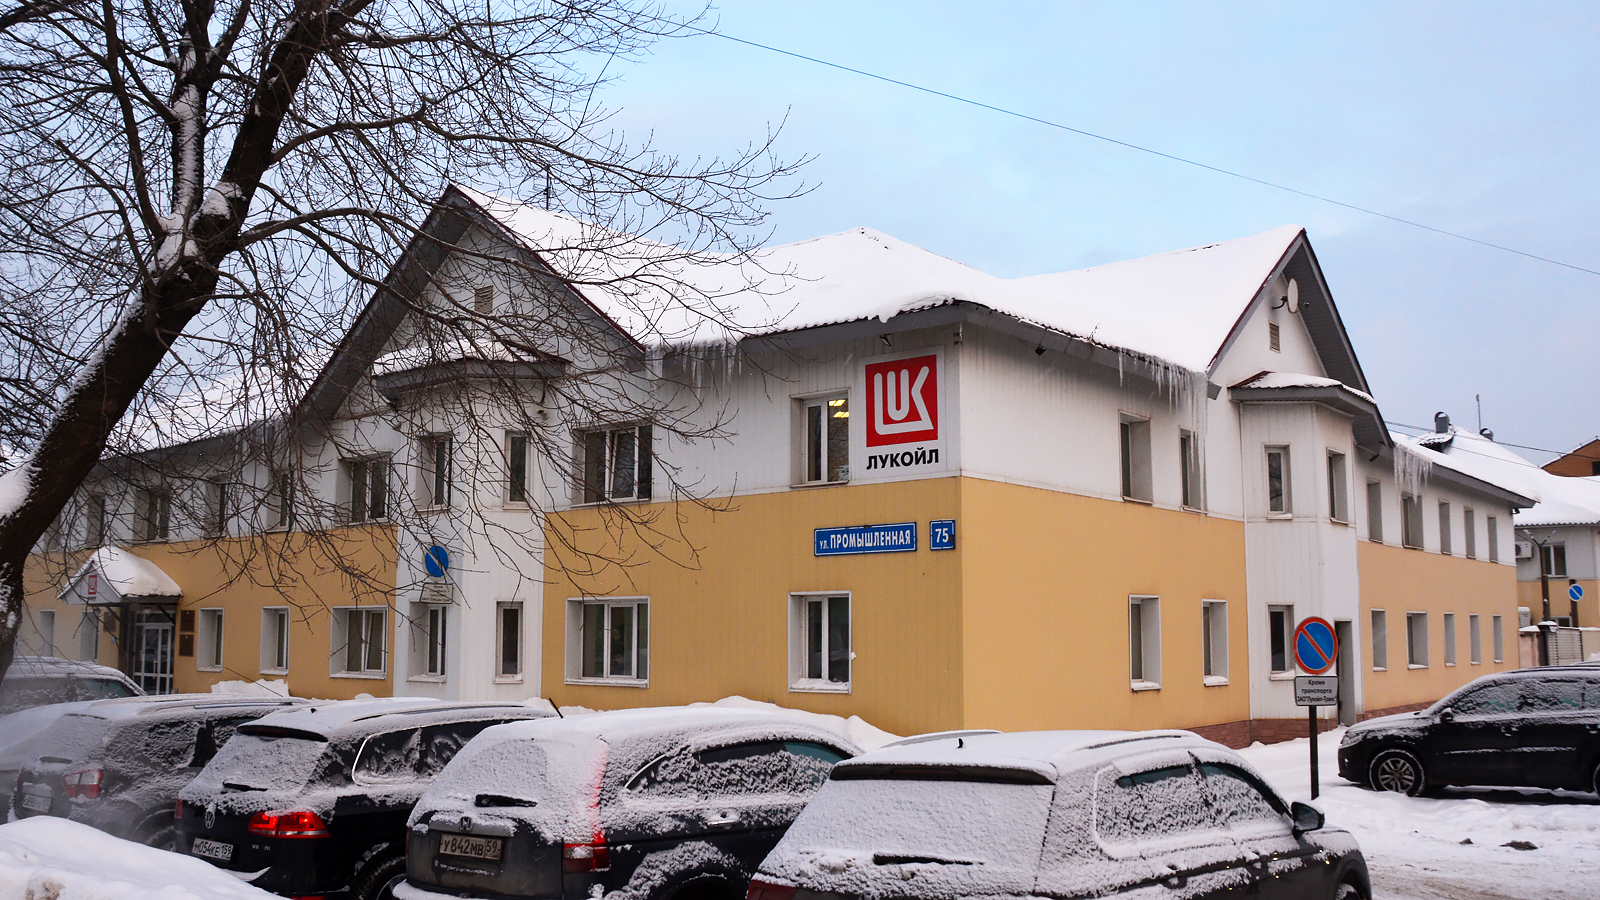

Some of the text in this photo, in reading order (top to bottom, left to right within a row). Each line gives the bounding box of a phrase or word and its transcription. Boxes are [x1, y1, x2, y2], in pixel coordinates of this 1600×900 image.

[866, 447, 939, 470] ЛУКОЙЛ
[830, 530, 911, 549] ПРОМЫШЛЕННАЯ
[935, 528, 949, 543] 75
[220, 844, 232, 856] 159
[444, 838, 498, 856] У842МВ 59
